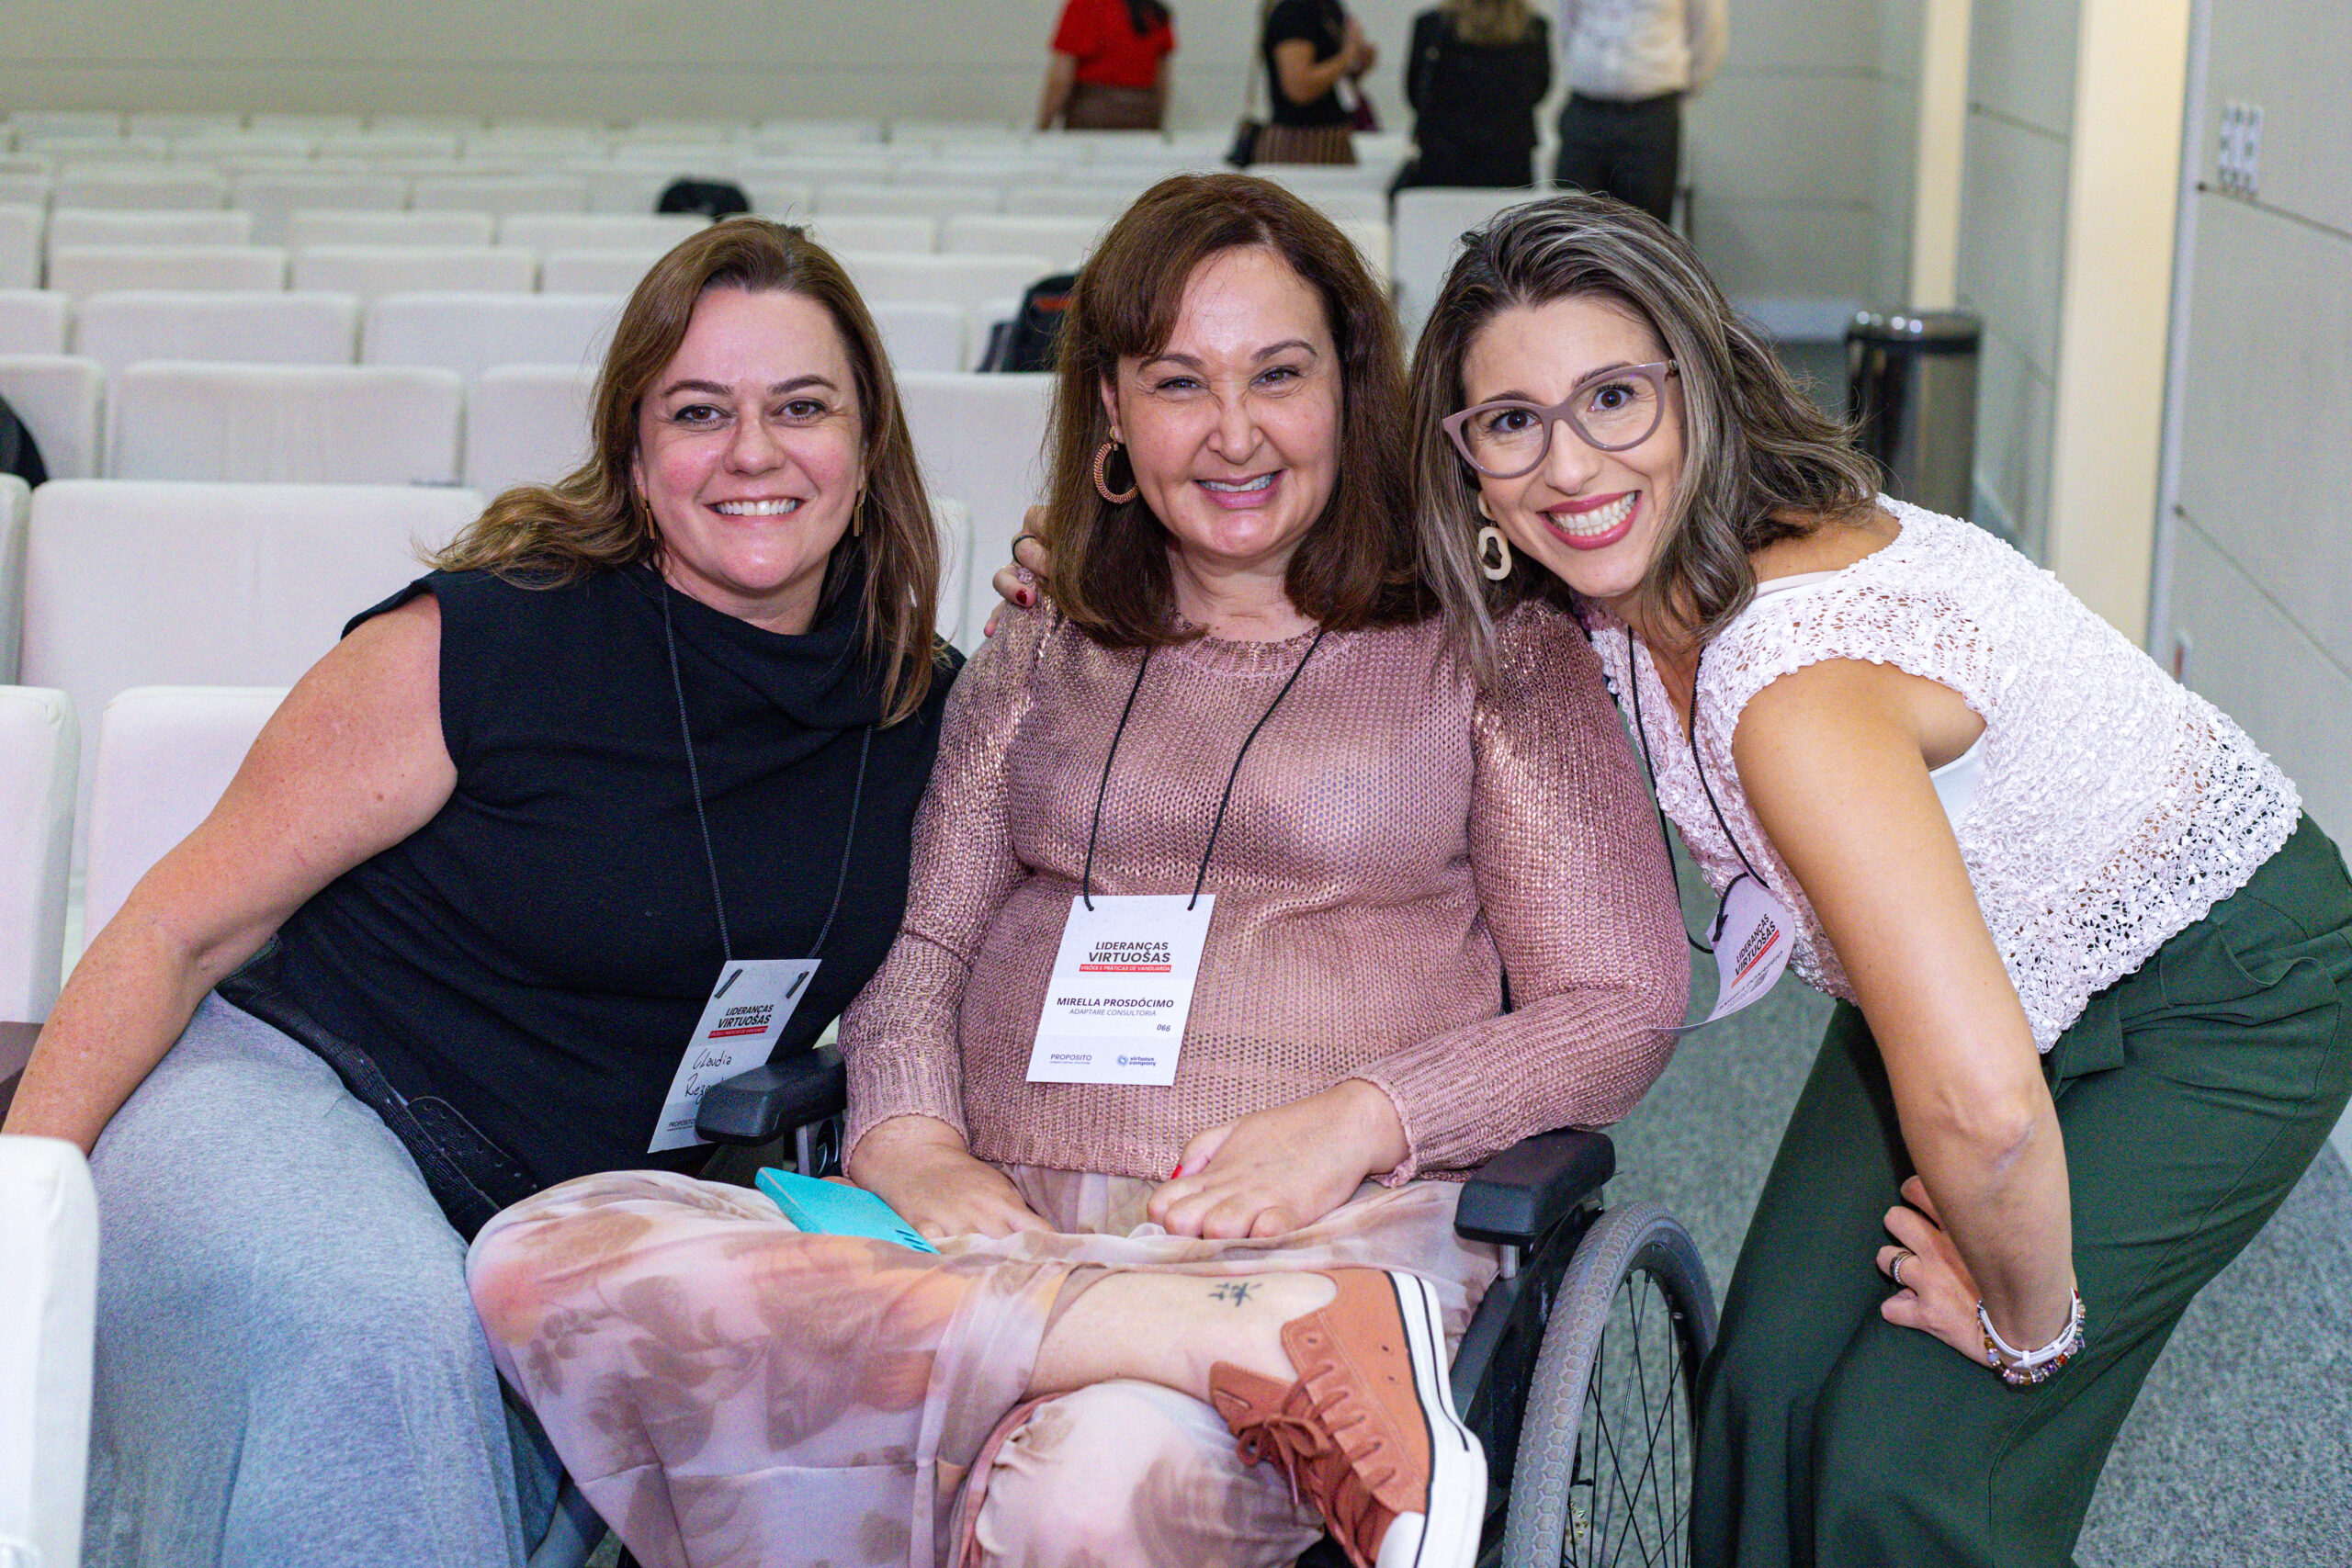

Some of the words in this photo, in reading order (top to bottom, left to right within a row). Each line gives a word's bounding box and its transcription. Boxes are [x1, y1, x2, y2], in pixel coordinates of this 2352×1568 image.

[1736, 914, 1770, 963] LIDERANÇAS
[1095, 942, 1169, 953] LIDERANÇAS
[1735, 920, 1776, 976] VIRTUOSAS
[1089, 952, 1170, 963] VIRTUOSAS
[1057, 998, 1101, 1007] MIRELLA
[1102, 998, 1174, 1009] PROSDÓCIMO
[725, 1004, 774, 1016] LIDERANÇAS
[1106, 1009, 1157, 1017] CONSULTORIA
[718, 1014, 771, 1028] VIRTUOSAS
[1157, 1023, 1171, 1032] 066
